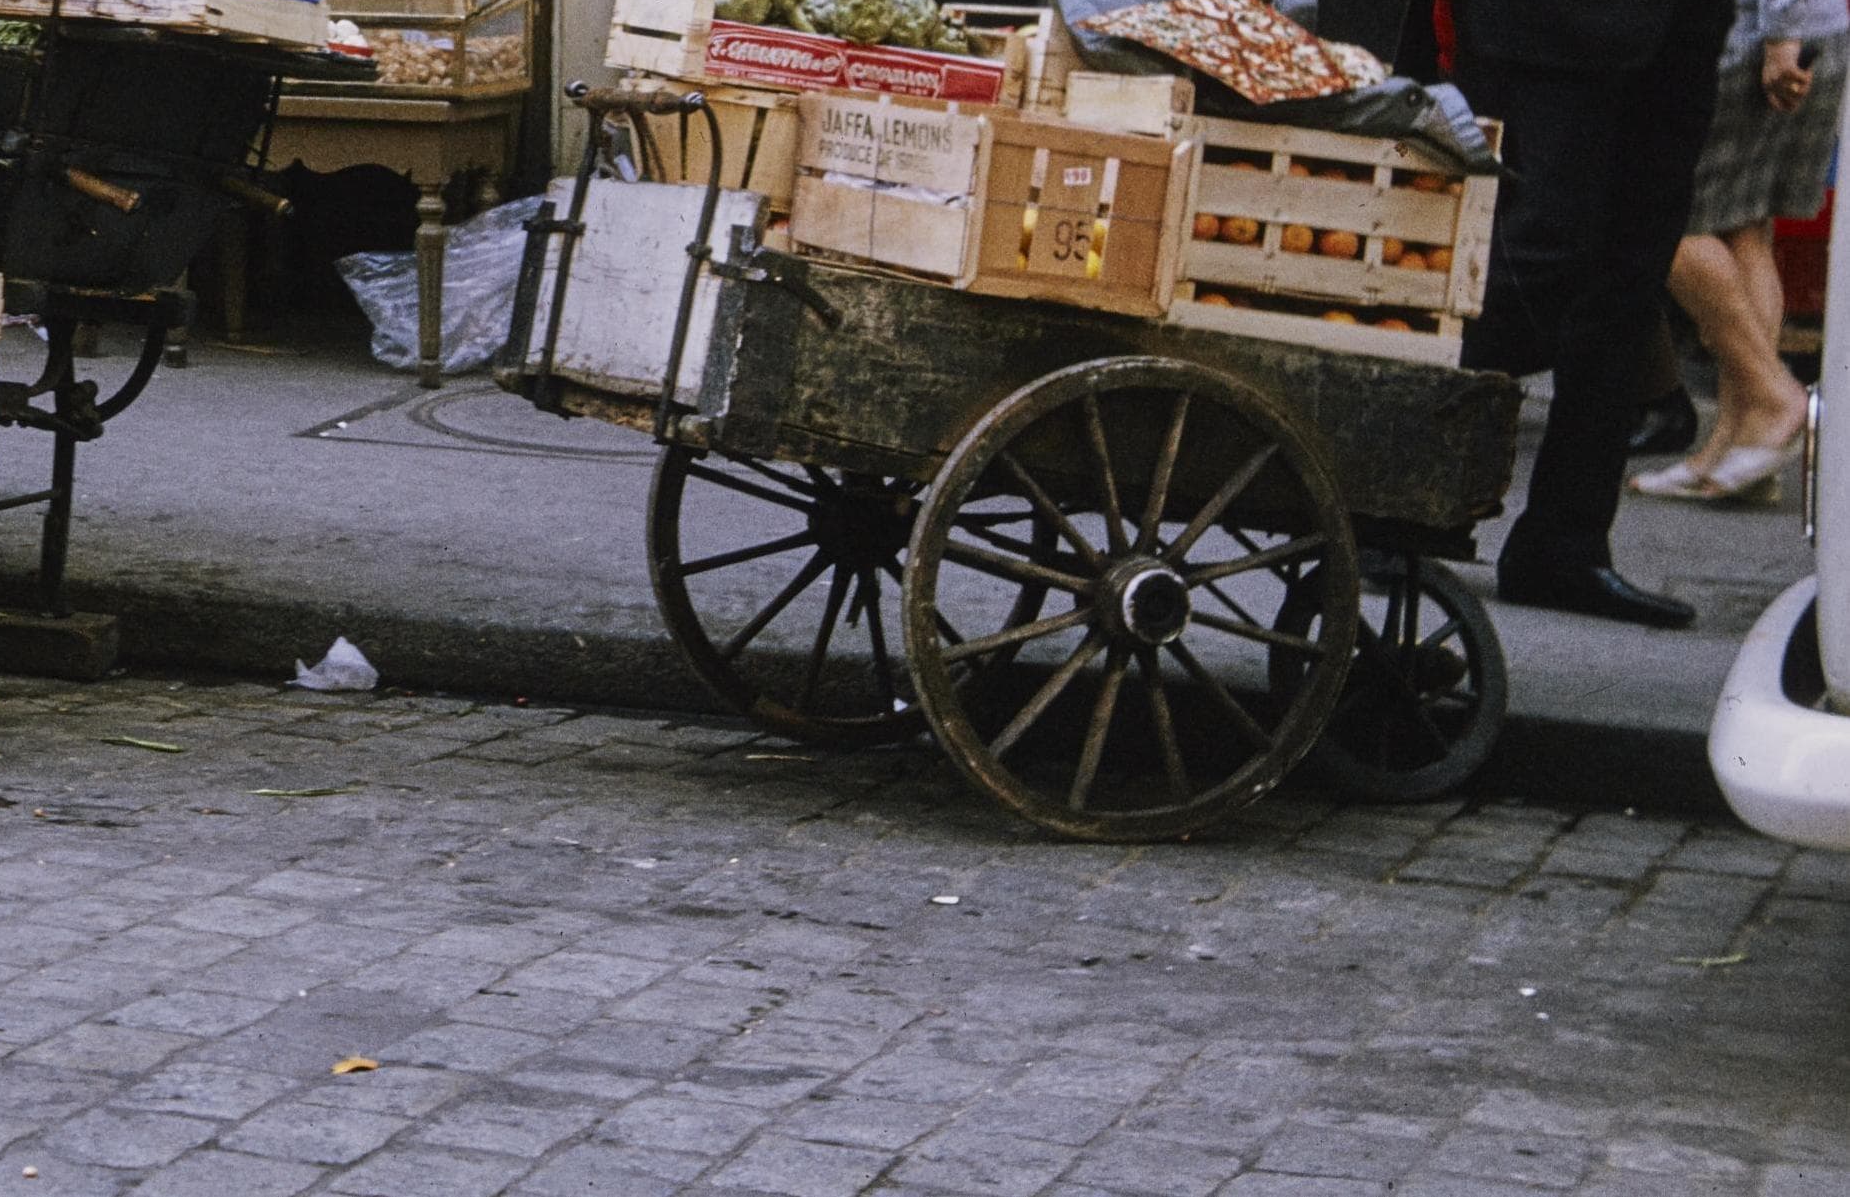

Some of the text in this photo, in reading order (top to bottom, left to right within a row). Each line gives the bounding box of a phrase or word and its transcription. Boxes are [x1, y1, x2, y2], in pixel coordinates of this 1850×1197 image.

[817, 138, 873, 165] PRODUCE
[821, 108, 954, 155] JAFFA LEMONS
[1052, 220, 1091, 262] 95
